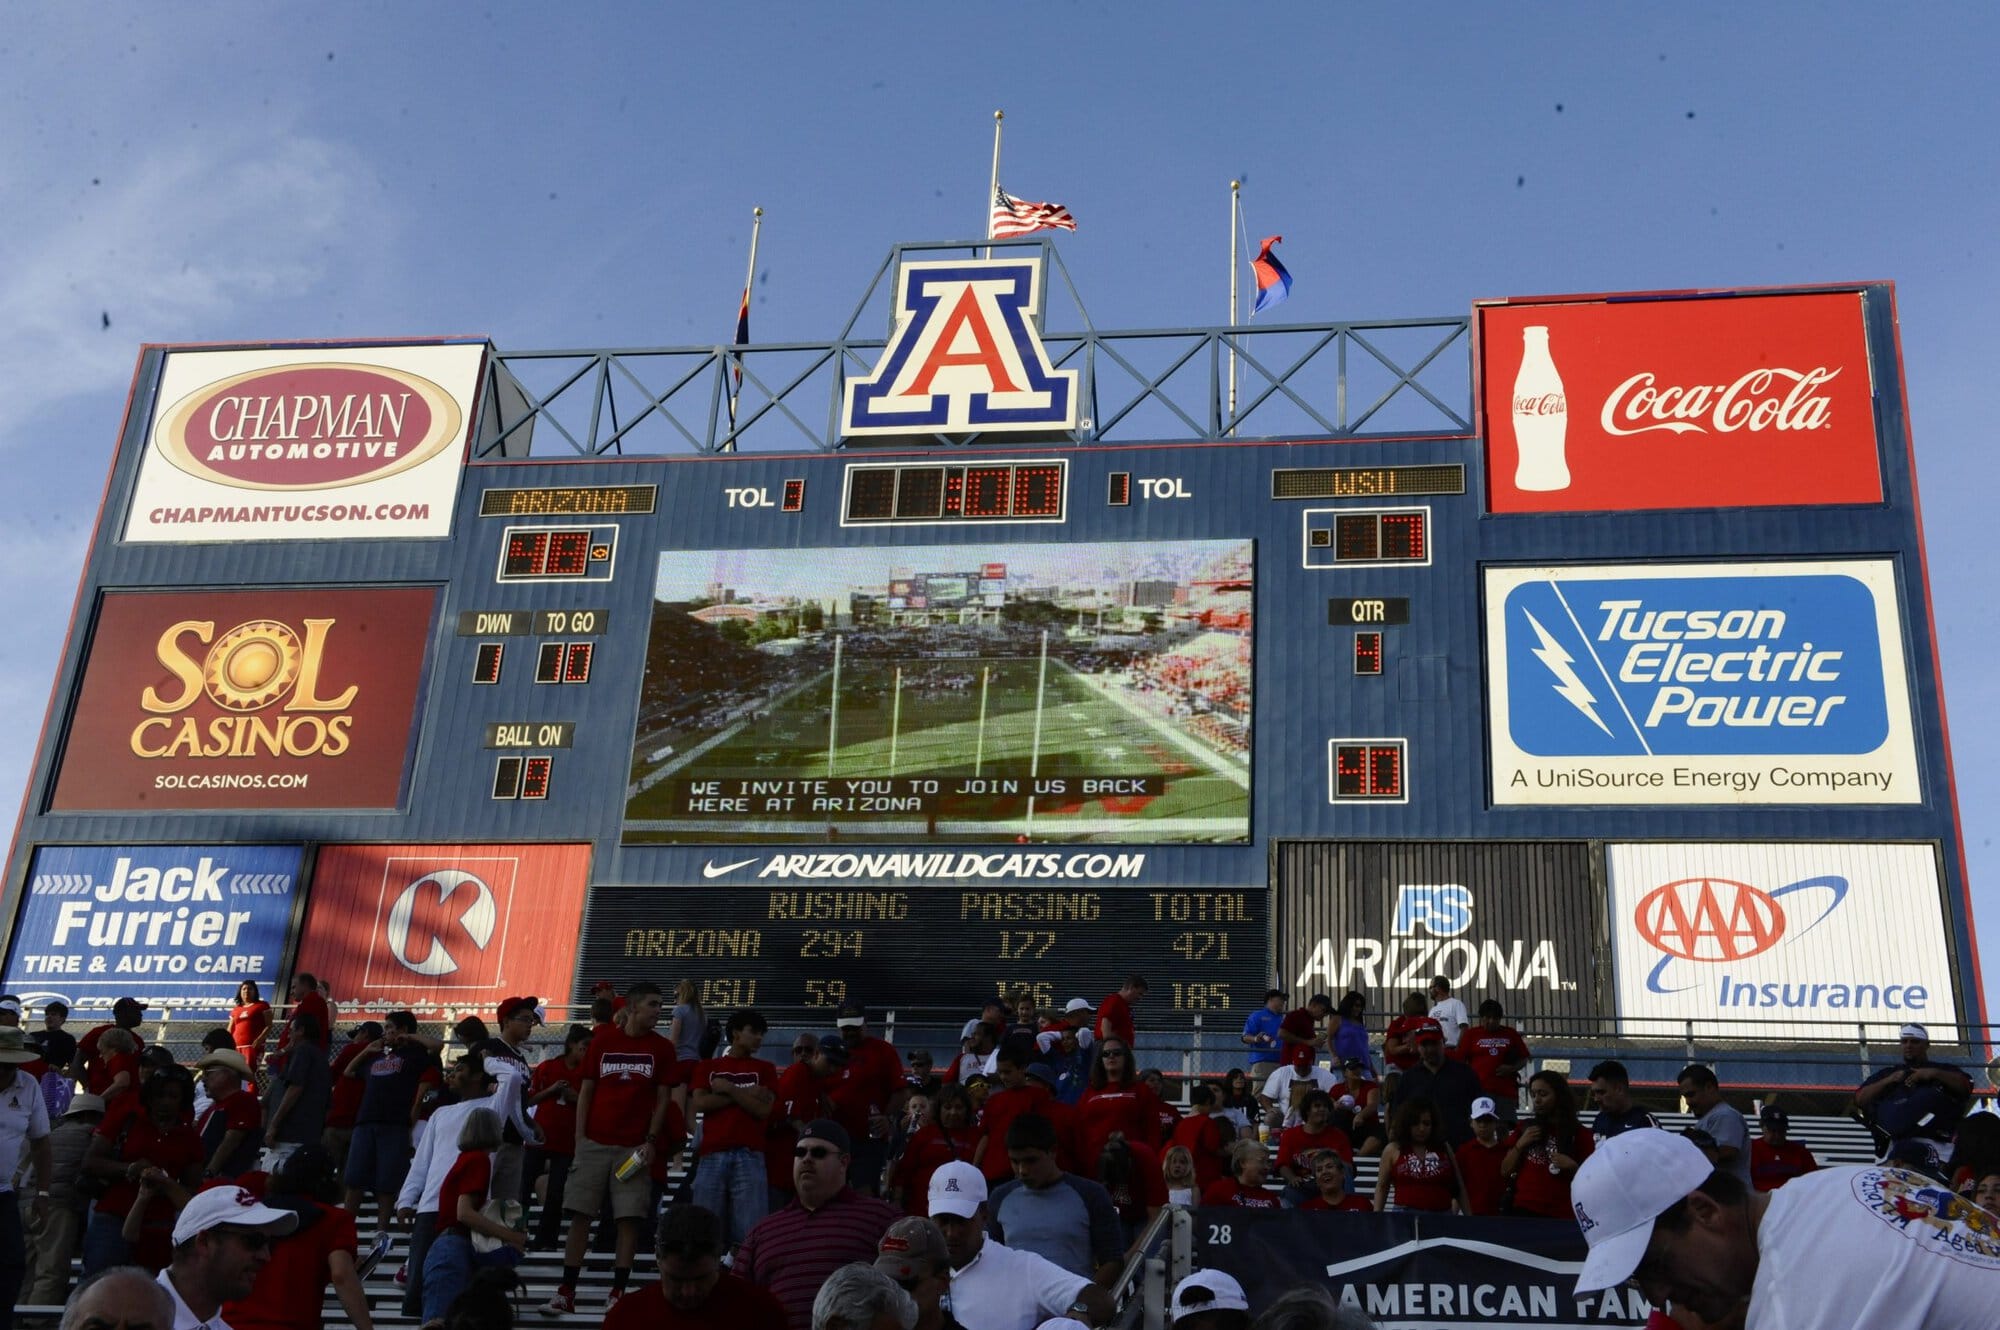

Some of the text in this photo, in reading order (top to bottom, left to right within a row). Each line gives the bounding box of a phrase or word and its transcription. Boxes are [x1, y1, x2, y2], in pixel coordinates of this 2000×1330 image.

[841, 258, 1078, 436] A
[1601, 366, 1843, 436] Coca-Cola
[208, 393, 412, 442] CHAPMAN
[207, 441, 398, 461] AUTOMOTIVE
[783, 483, 802, 511] 3
[1138, 478, 1192, 499] TOL
[1334, 471, 1396, 495] WSU
[511, 490, 628, 514] ARIZONA
[725, 488, 775, 508] TOL
[149, 503, 430, 524] CHAPMANTUCSON.COM
[509, 533, 589, 574] 48
[475, 613, 512, 634] DWN
[547, 611, 595, 633] TO GO
[1351, 600, 1385, 622] QTR
[1597, 600, 1786, 641] Tucson
[141, 618, 359, 713] SOL
[553, 645, 591, 682] 10
[1357, 634, 1380, 672] 4
[1619, 642, 1843, 682] Electric
[1643, 686, 1847, 727] Power
[130, 716, 353, 758] CASINOS
[495, 725, 563, 746] BALL ON
[154, 774, 309, 789] SOLCASINOS.COM
[524, 760, 551, 796] 9
[1337, 749, 1399, 795] 40
[1511, 767, 1894, 791] A UniSource Energy Company
[691, 779, 1147, 795] WE INVITE YOU TO JOIN US BACK
[688, 796, 922, 812] HERE AT ARIZONA
[94, 857, 230, 902] Jack
[757, 853, 1146, 879] ARIZONAWILDCATS.COM
[768, 892, 1253, 921] RUSHING PASSING TOTAL
[1391, 884, 1474, 937] FS
[1648, 879, 1777, 960] AAA
[52, 901, 251, 947] Furrier
[625, 929, 1231, 960] ARIZONA 294 177 471
[24, 955, 265, 974] TIRE & AUTO CARE
[1296, 937, 1561, 990] ARIZONA
[410, 997, 438, 1014] do
[803, 980, 847, 1008] 59
[1170, 983, 1231, 1010] 185
[1718, 975, 1929, 1010] Insurance
[602, 1062, 653, 1075] WILDCATS
[945, 1178, 960, 1192] A
[1208, 1223, 1233, 1246] 28
[1337, 1283, 1558, 1318] AMERICAN
